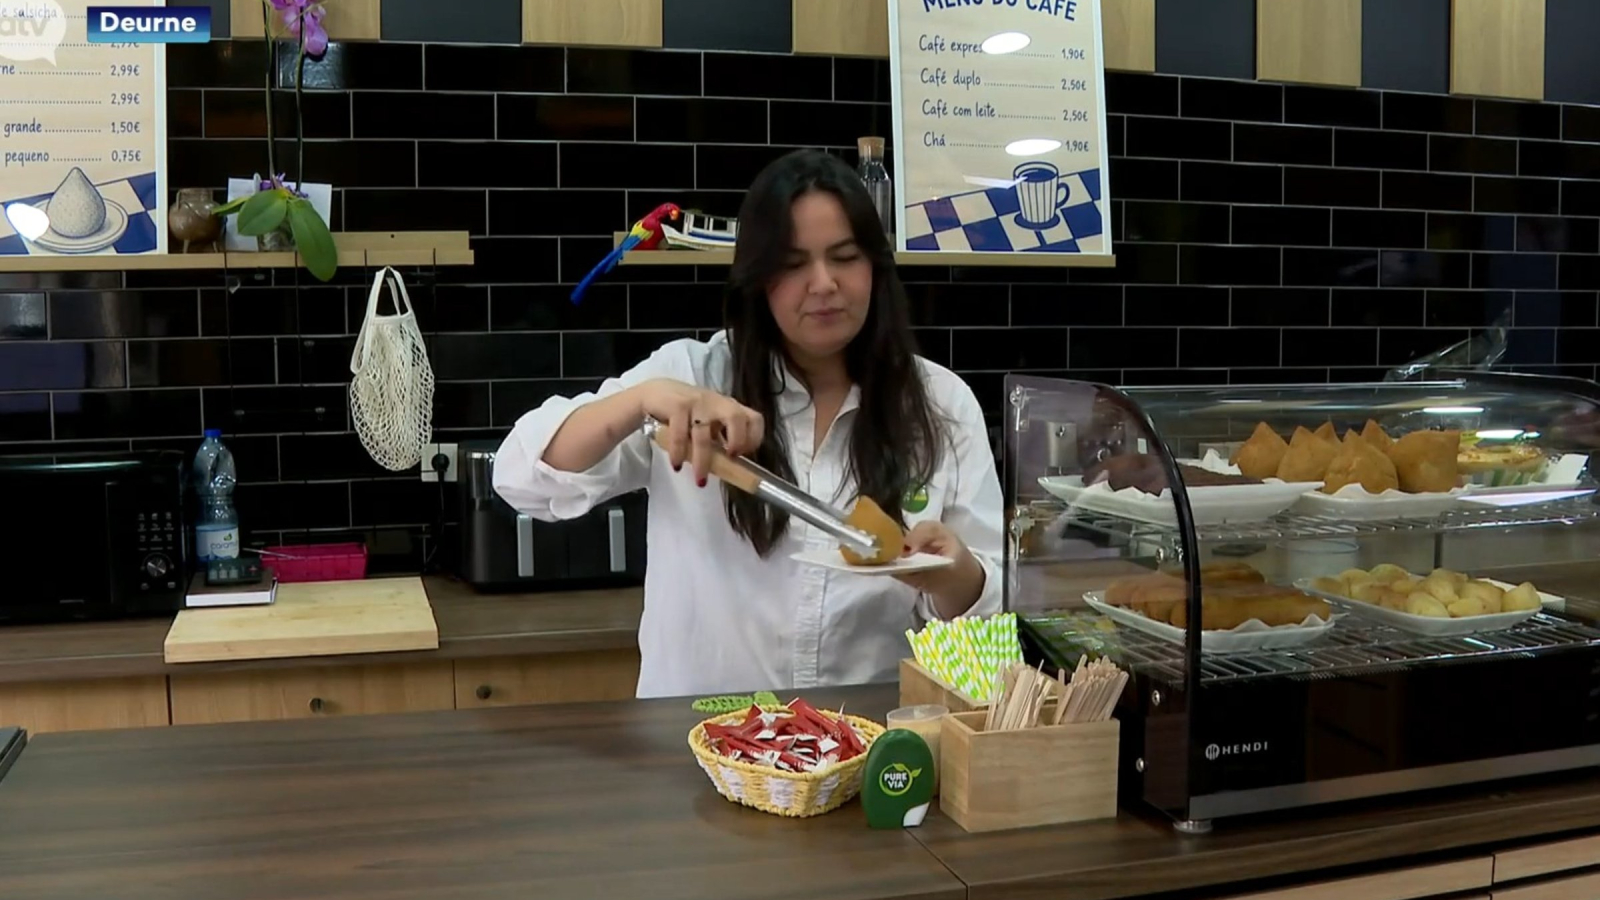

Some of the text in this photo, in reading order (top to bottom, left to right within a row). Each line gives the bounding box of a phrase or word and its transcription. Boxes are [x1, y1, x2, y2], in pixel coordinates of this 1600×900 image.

[919, 34, 946, 55] Café
[1062, 48, 1086, 60] 1,90€
[110, 64, 140, 77] 2,99€
[920, 68, 1087, 91] Café duplo 2,50€
[110, 93, 140, 106] 2,99€
[922, 99, 1089, 122] Café com leite 2,50€
[4, 116, 141, 138] grande 1,50€
[923, 131, 1089, 152] Chá 1,90€
[5, 150, 142, 168] pequeno 0,75€
[1222, 741, 1268, 755] HENDI
[883, 772, 907, 782] PURE
[887, 780, 905, 789] VIA
